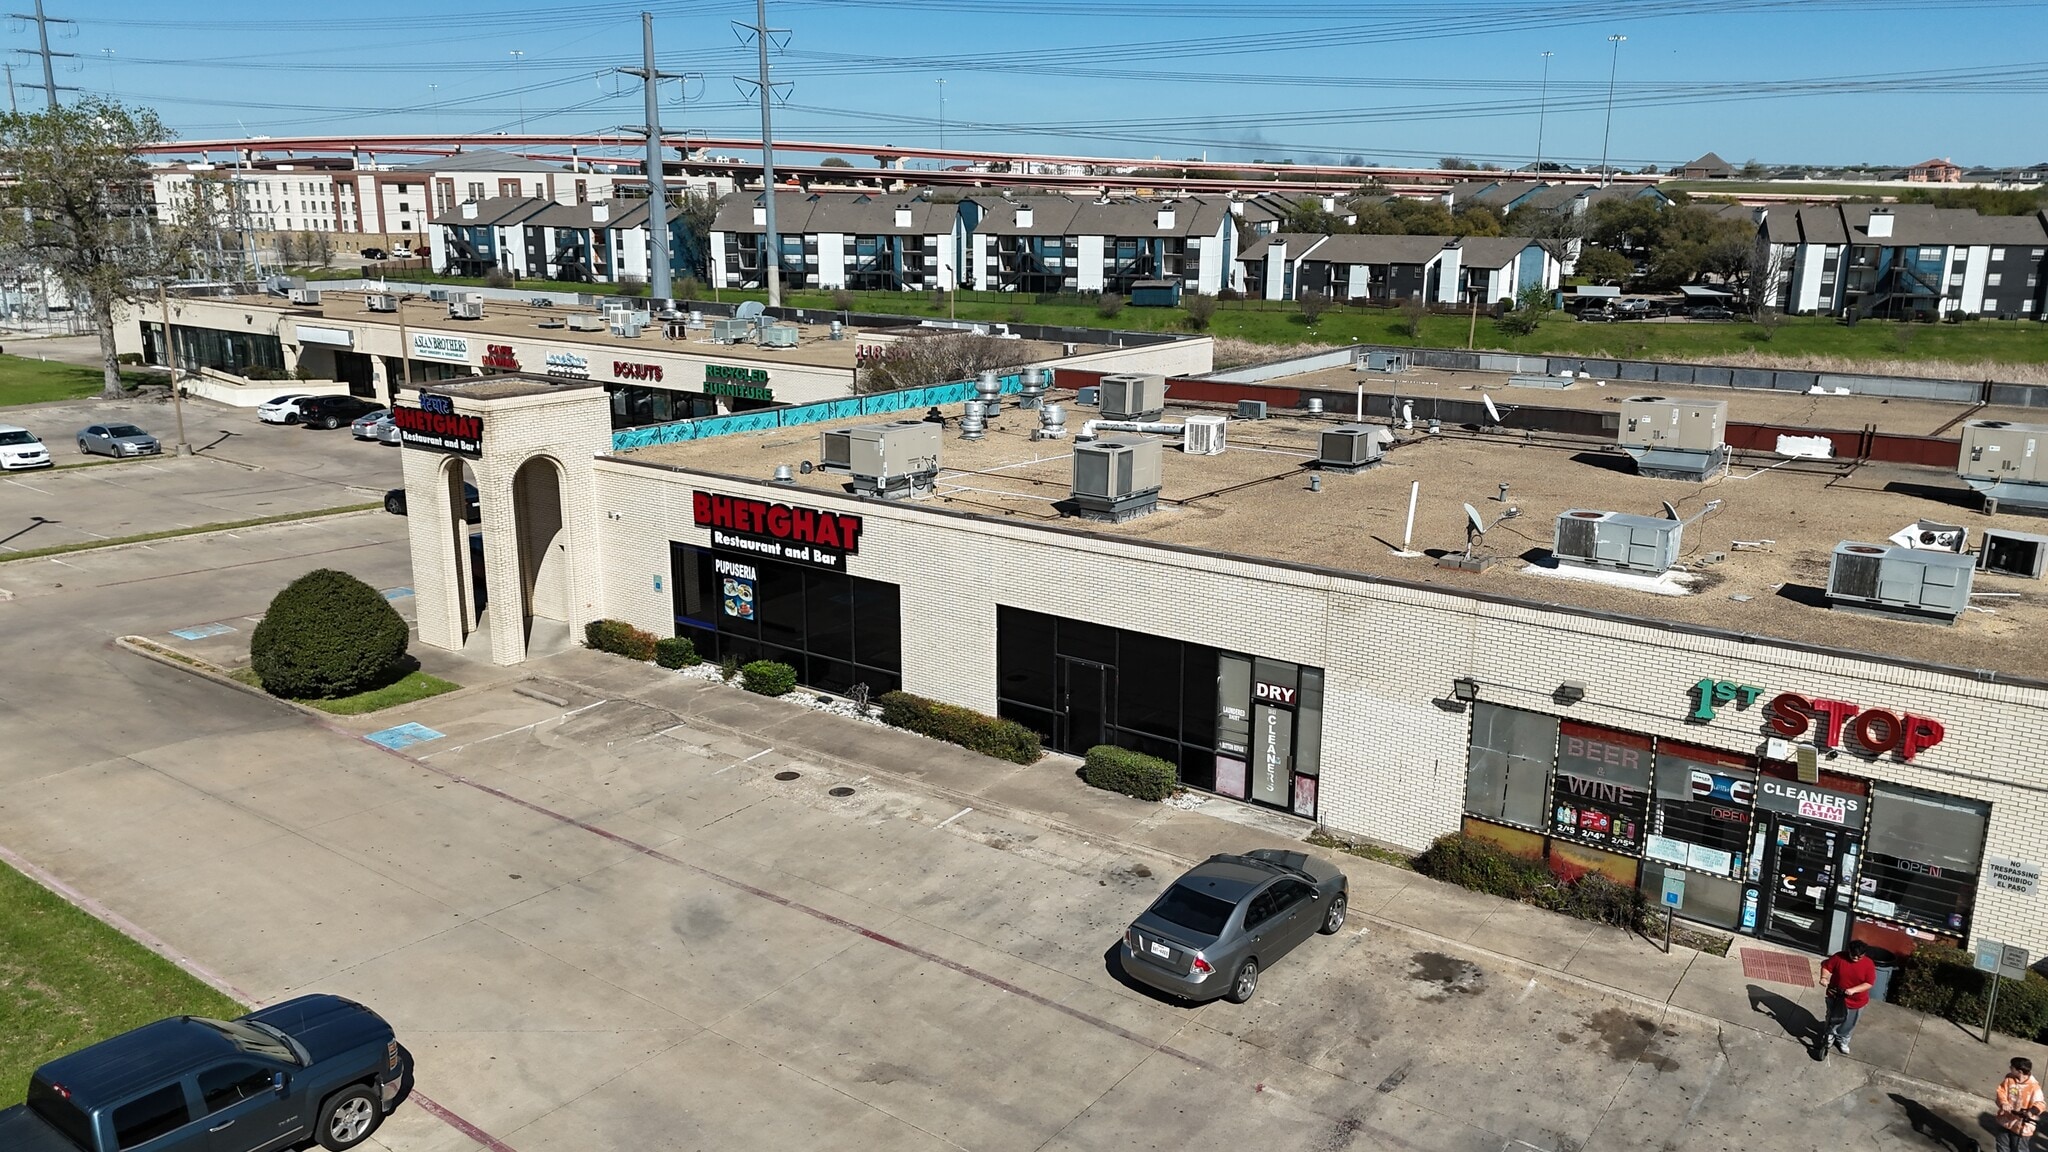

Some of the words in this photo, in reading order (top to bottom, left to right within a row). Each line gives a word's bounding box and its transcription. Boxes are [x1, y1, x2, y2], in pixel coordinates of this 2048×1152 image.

[414, 335, 433, 349] ASIAN
[433, 337, 467, 352] BROTHERS
[613, 361, 664, 382] DONUTS
[705, 364, 769, 383] RECYCLED
[703, 381, 773, 400] FURNITURE
[394, 406, 480, 439] BHETGHAT
[402, 430, 443, 446] Restaurant
[444, 439, 459, 449] and
[460, 440, 475, 452] Bar
[693, 491, 859, 550] BHETGHAT
[714, 531, 782, 556] Restaurant
[784, 546, 810, 561] and
[813, 549, 838, 566] Bar
[715, 559, 757, 581] PUPUSERIA
[1256, 682, 1294, 702] DRY
[1770, 691, 1945, 762] STOP
[1567, 737, 1640, 769] BEER
[1597, 766, 1605, 777] &
[1567, 776, 1635, 806] WINE
[1763, 783, 1859, 811] CLEANERS
[1713, 808, 1749, 824] OPEN
[1801, 801, 1843, 815] ATM
[1990, 864, 2039, 880] TRESPASSING
[1993, 873, 2033, 886] PROHIBIDO
[2007, 884, 2027, 892] PASO
